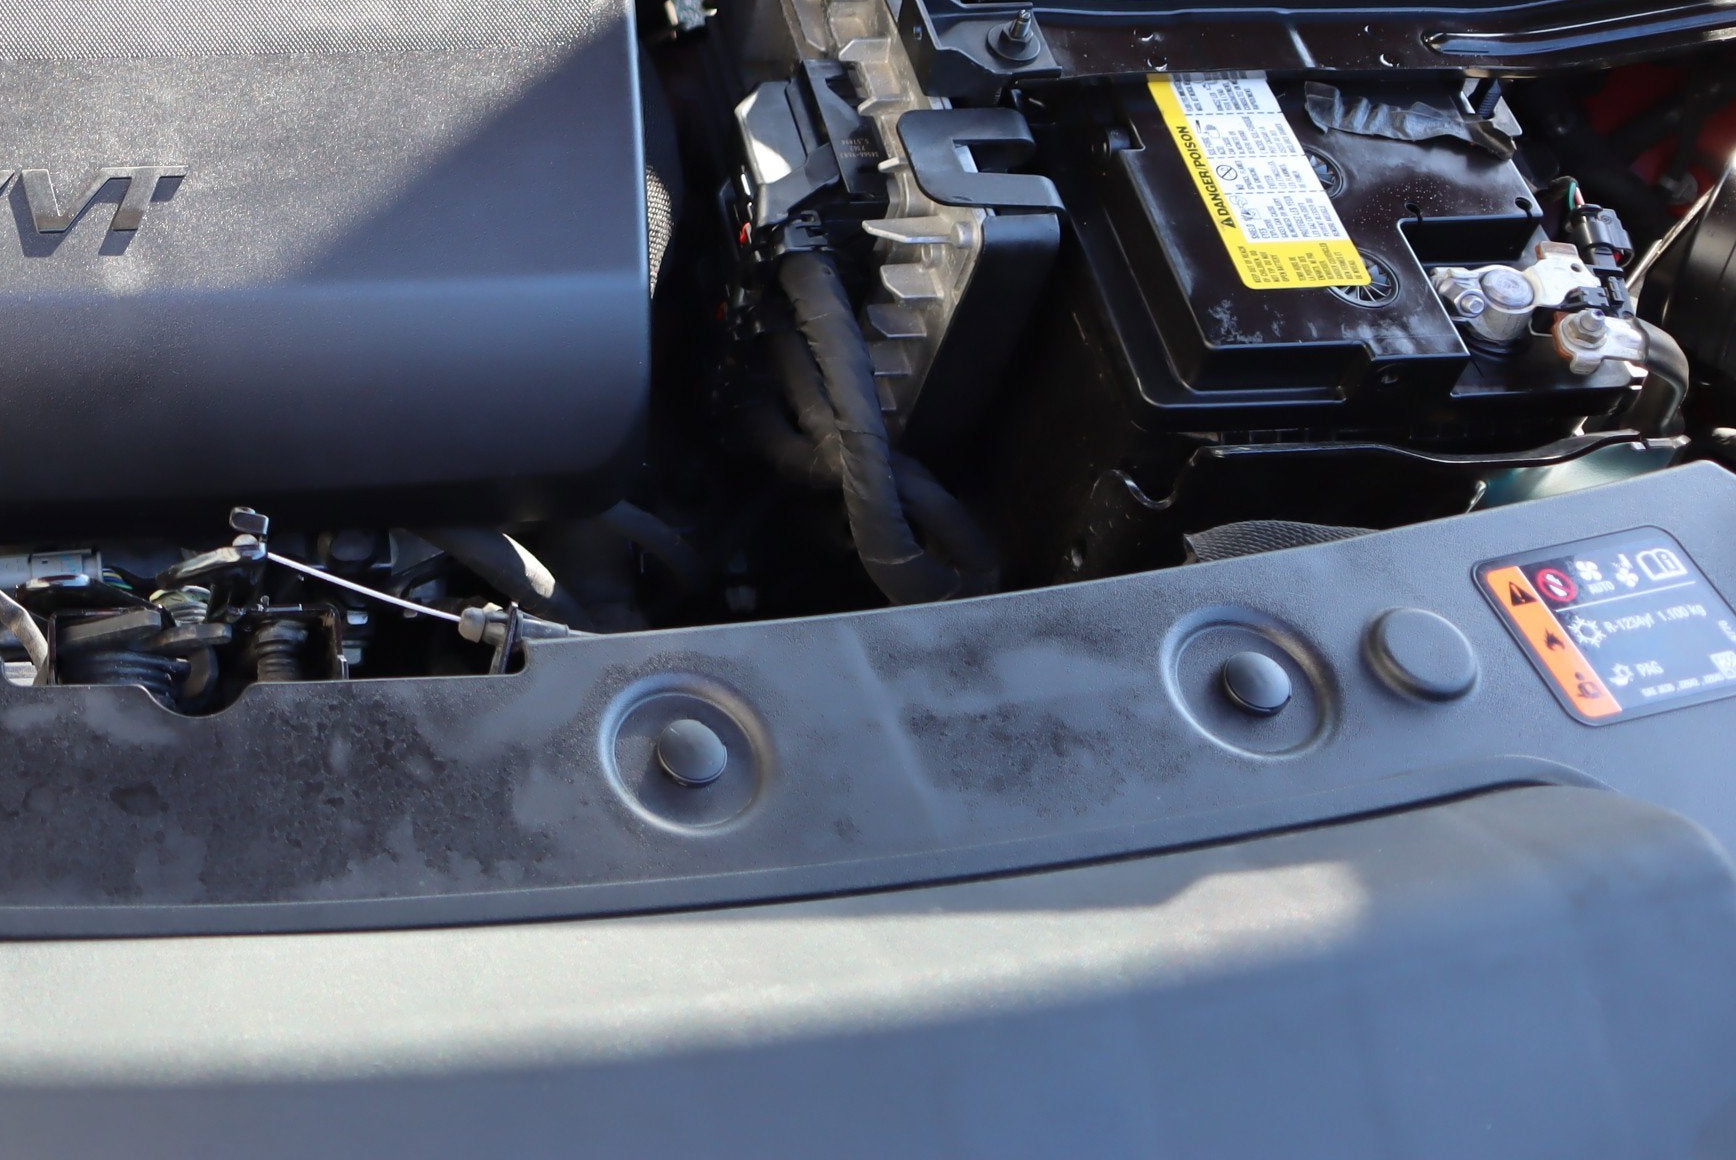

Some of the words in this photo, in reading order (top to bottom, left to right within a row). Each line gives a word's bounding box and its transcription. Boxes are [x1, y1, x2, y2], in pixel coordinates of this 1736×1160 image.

[1175, 125, 1230, 216] DANGER/POISON
[1587, 581, 1615, 595] AUTO
[1636, 660, 1664, 677] PAG
